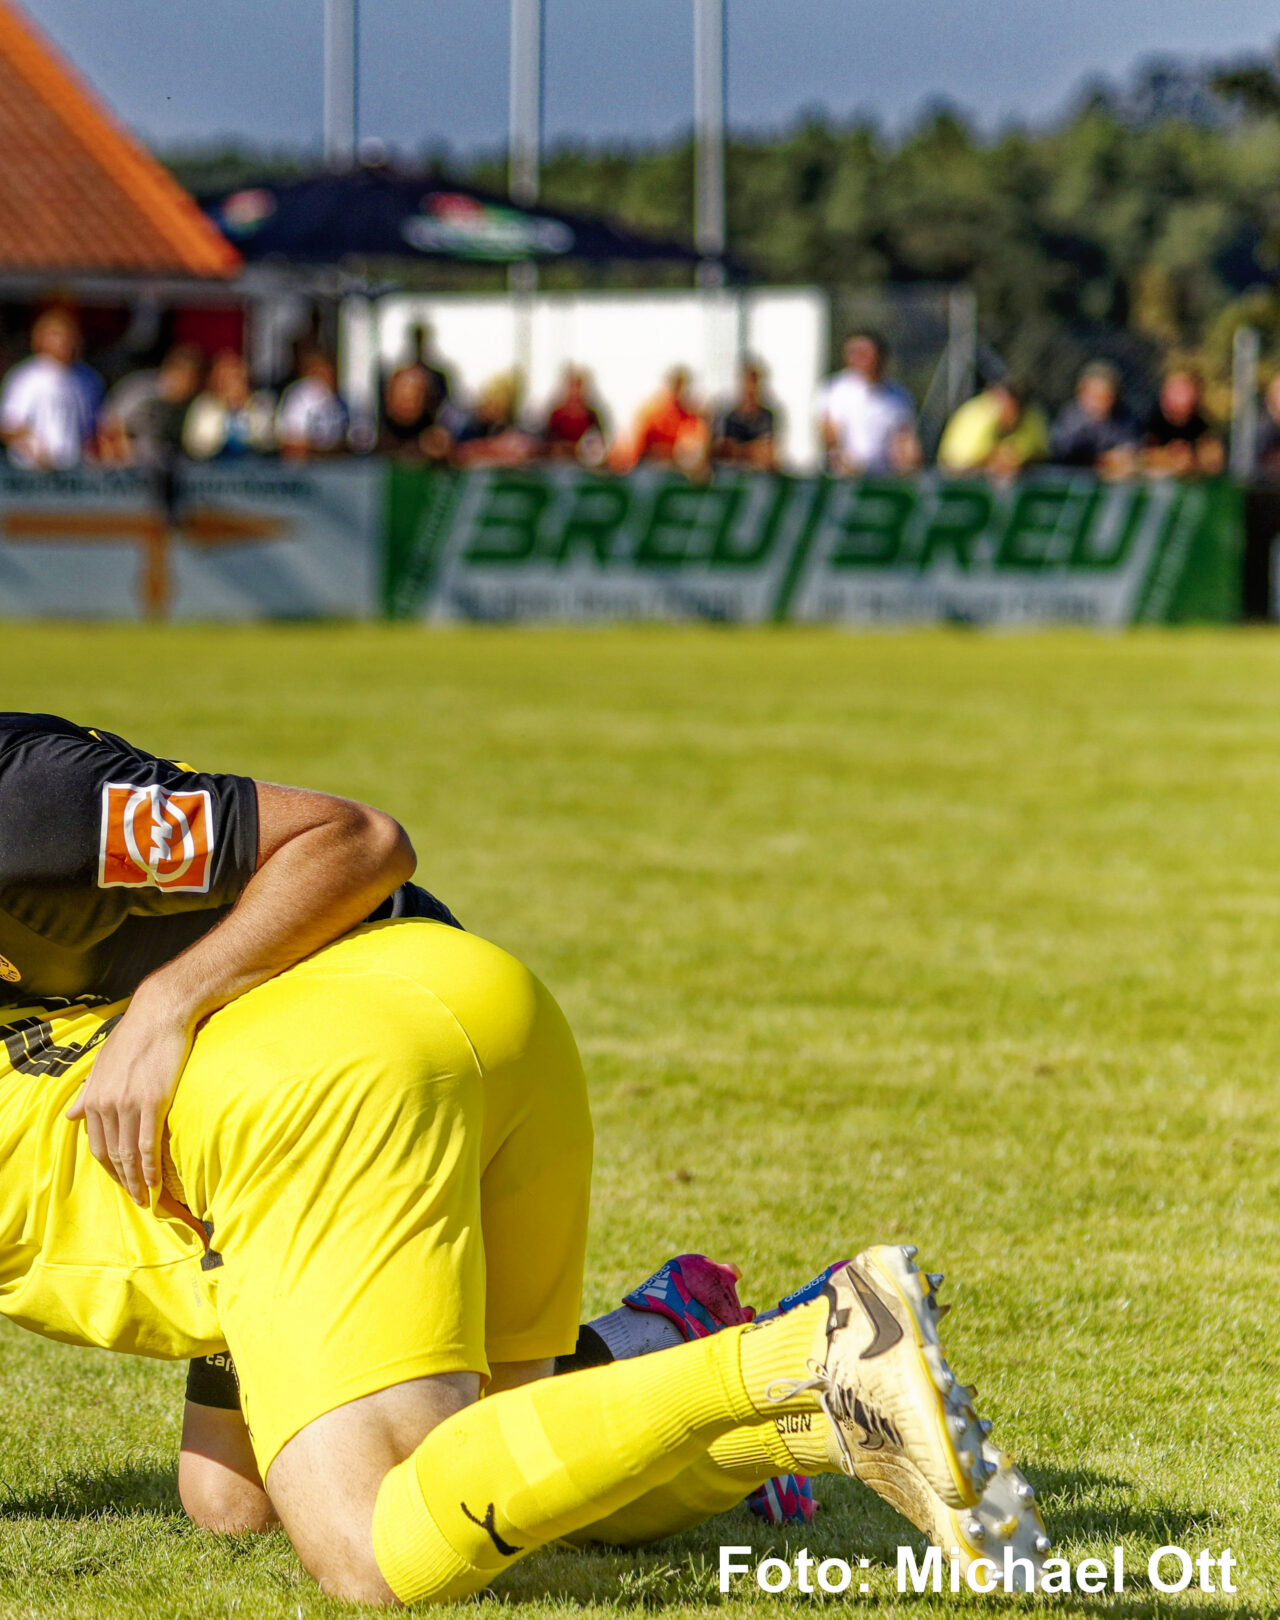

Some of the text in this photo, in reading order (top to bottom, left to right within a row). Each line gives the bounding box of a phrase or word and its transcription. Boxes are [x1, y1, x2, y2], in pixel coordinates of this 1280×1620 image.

[459, 479, 786, 570] BREU
[828, 486, 1150, 572] BREU
[775, 1413, 813, 1434] SIGN
